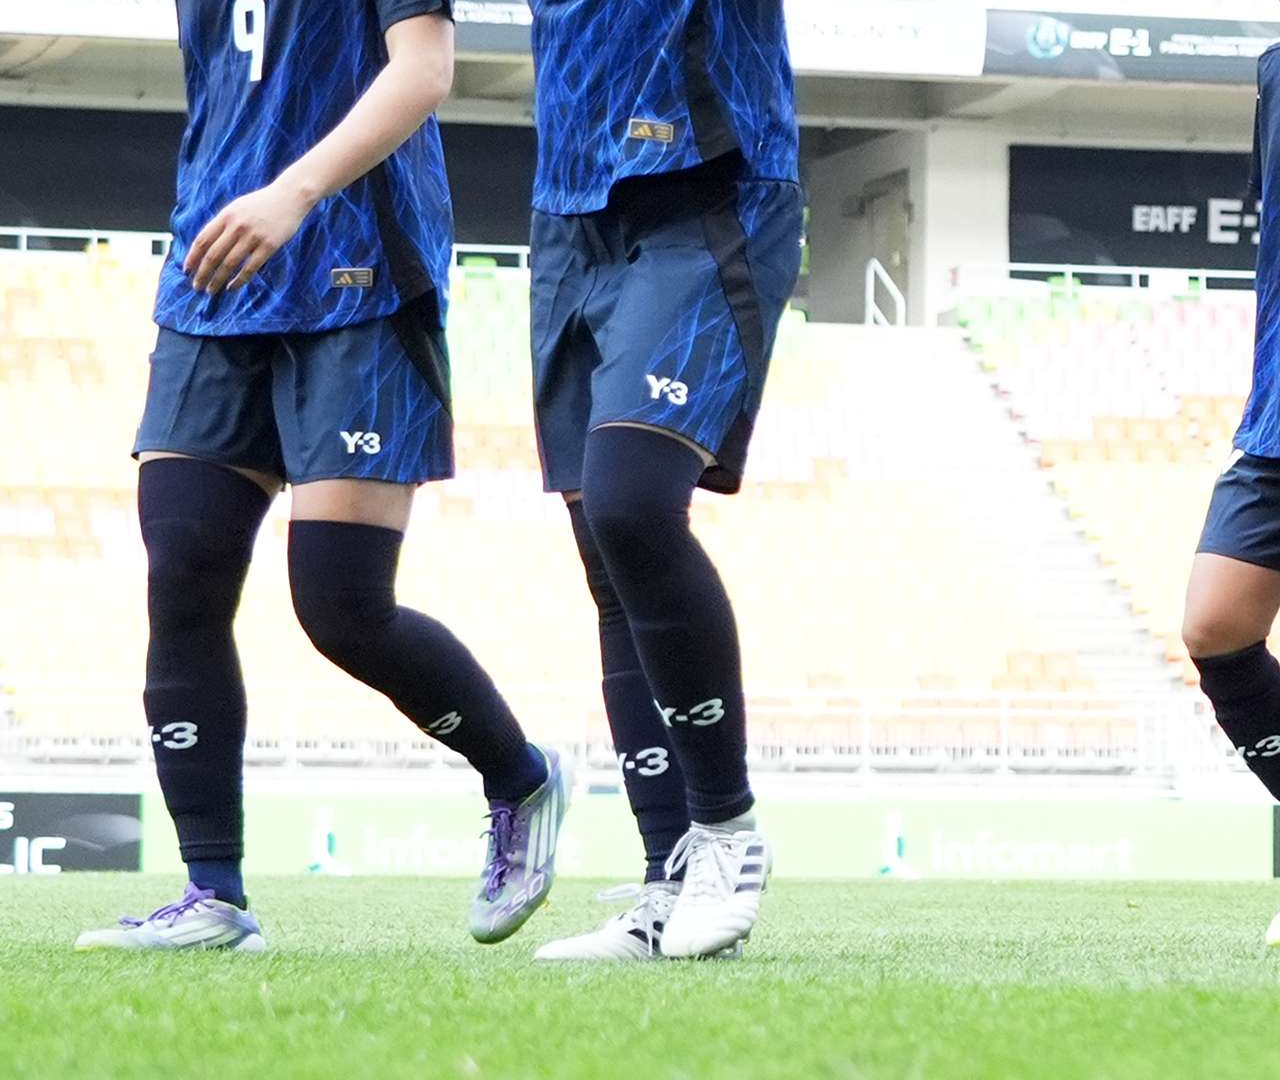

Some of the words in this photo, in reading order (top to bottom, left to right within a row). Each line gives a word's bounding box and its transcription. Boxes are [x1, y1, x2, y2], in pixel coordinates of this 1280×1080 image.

[1132, 204, 1198, 232] EAFF
[645, 374, 689, 406] Y-3
[340, 431, 381, 454] Y-3
[149, 721, 199, 750] -3
